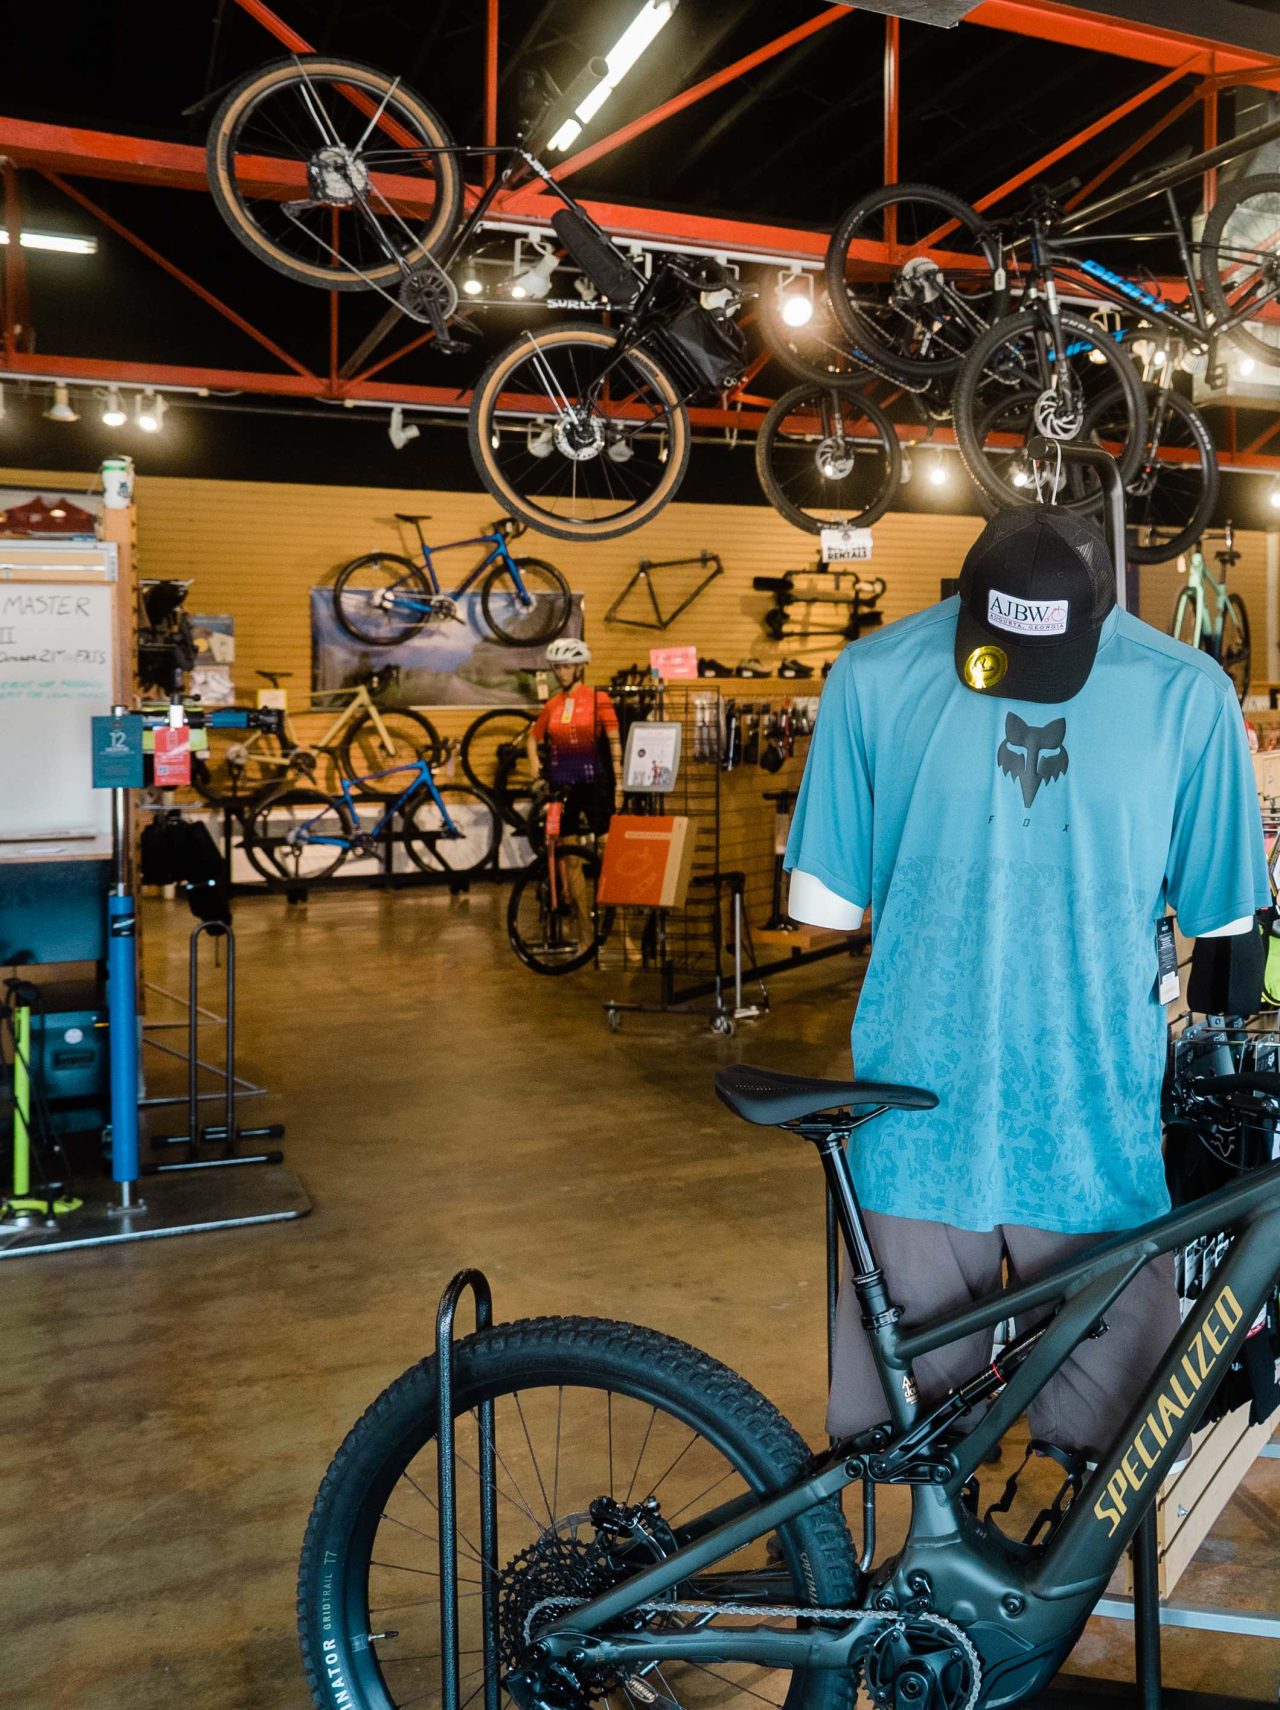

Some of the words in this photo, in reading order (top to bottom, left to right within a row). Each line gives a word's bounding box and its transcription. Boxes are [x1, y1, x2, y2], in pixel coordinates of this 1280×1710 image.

[546, 299, 598, 310] SURLY
[1189, 412, 1212, 450] KENDA
[2, 595, 91, 617] MASTER
[990, 596, 1050, 623] AJBW
[989, 613, 1025, 629] AUGUSTA,
[1028, 622, 1064, 630] GEORGIA
[109, 731, 127, 748] 12
[1093, 1285, 1244, 1538] SPECIALIZED
[323, 1550, 338, 1566] T7
